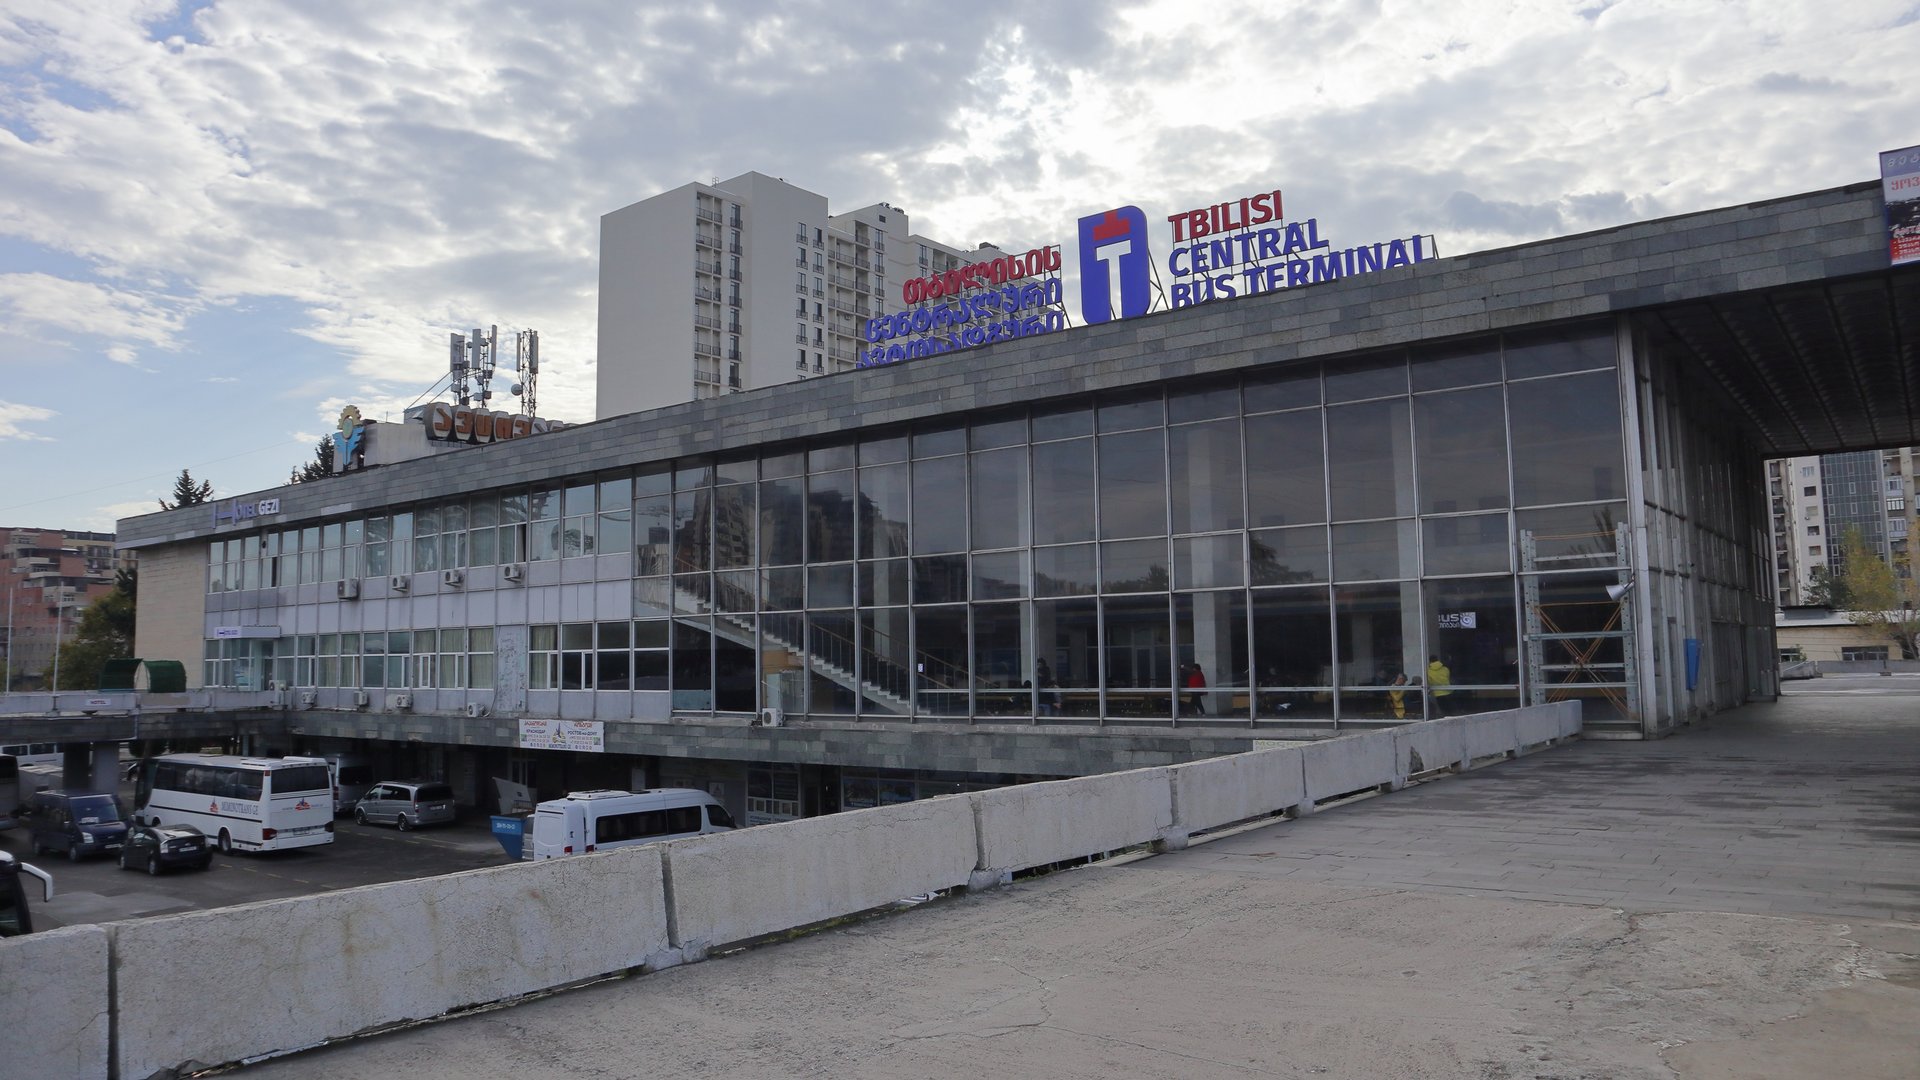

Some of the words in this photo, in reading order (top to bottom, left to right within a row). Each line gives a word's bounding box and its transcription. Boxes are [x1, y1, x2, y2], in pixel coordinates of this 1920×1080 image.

[1168, 190, 1283, 242] TBILISI
[903, 246, 1061, 304] თბილისის
[1168, 218, 1329, 277] CENTRAL
[1171, 273, 1236, 309] BUS
[1243, 235, 1434, 295] TERMINAL
[865, 277, 1063, 343] ცენტრალური
[258, 498, 280, 516] GEZI
[1438, 613, 1460, 622] US
